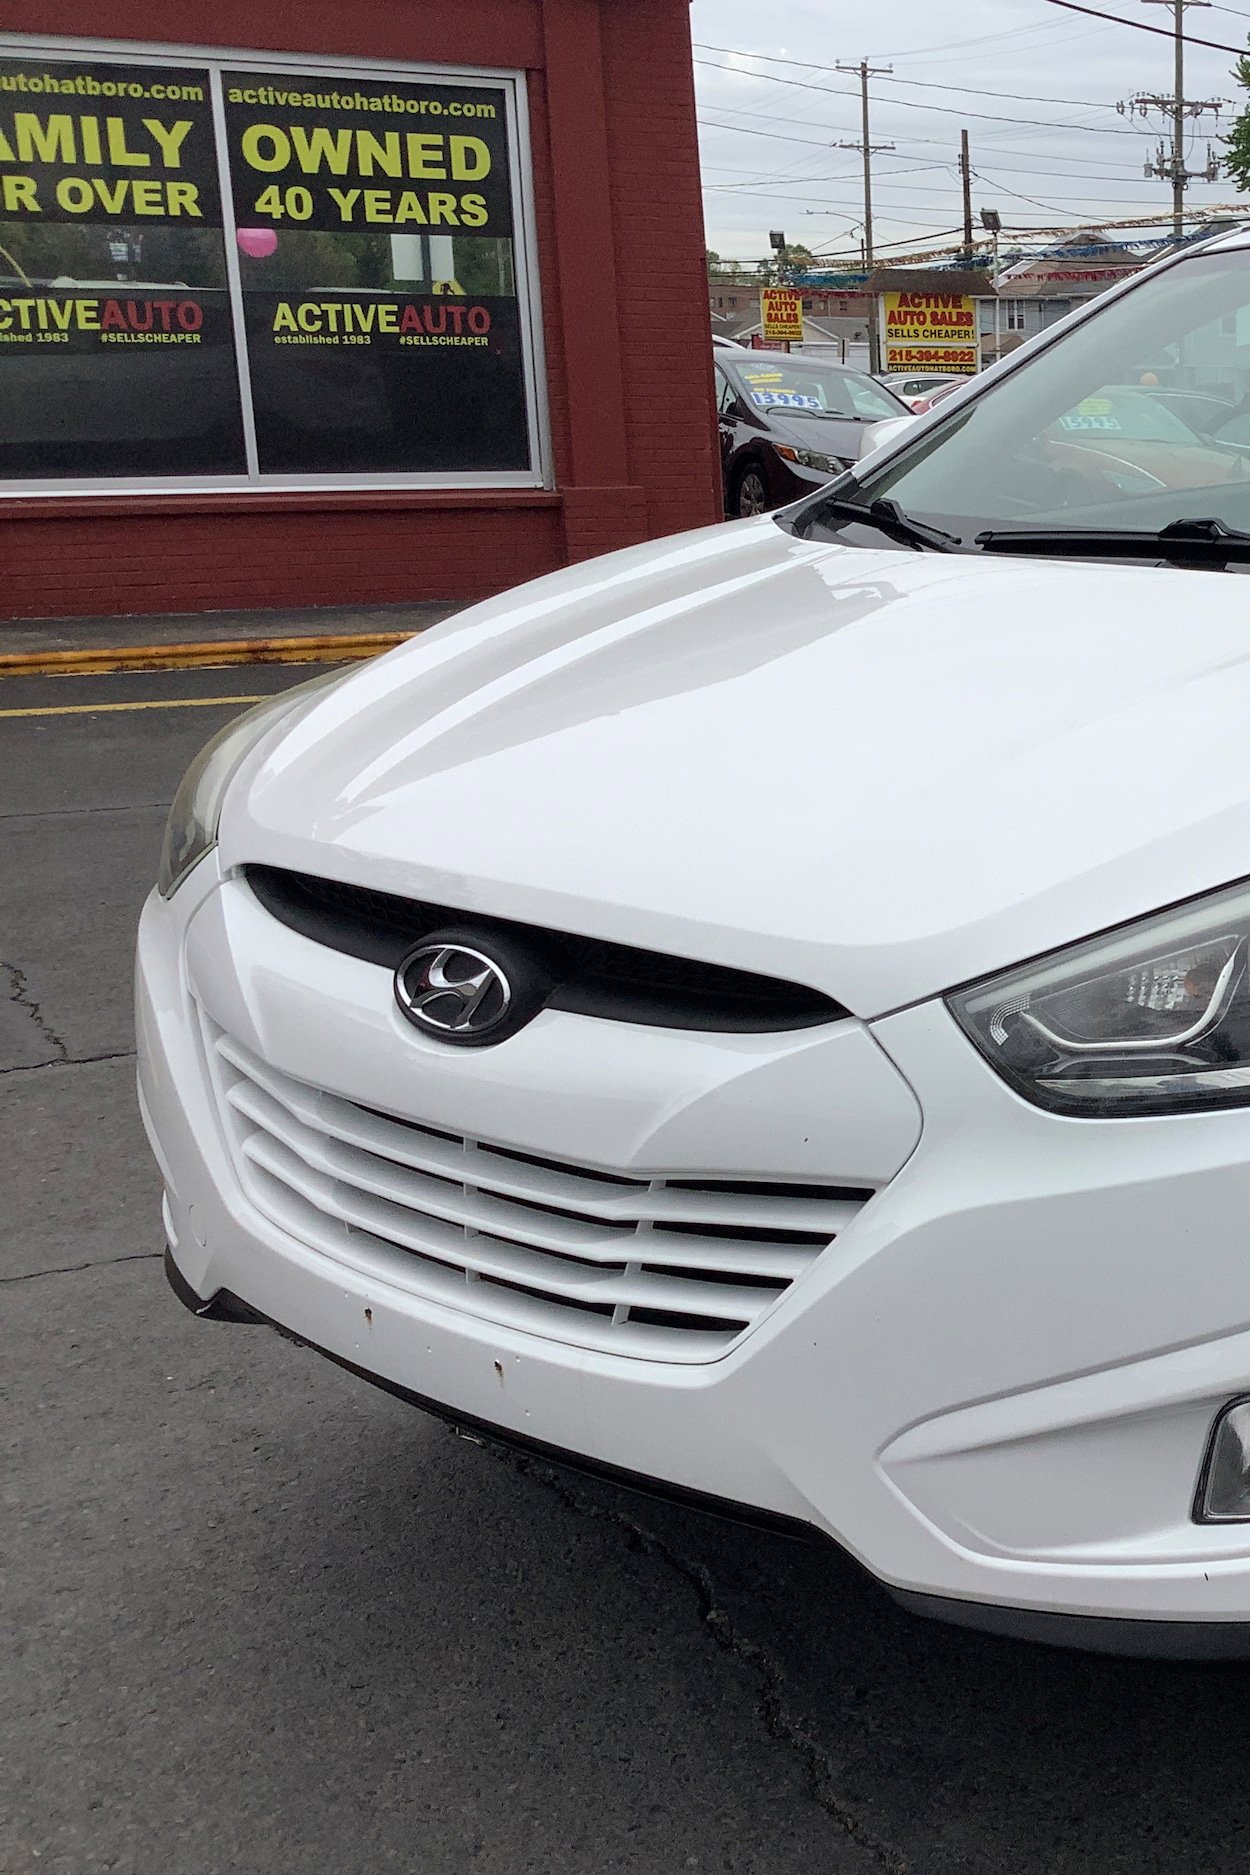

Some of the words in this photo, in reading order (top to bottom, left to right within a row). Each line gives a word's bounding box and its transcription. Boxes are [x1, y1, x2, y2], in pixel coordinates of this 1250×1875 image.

[228, 87, 496, 119] activeautohatboro.com
[242, 124, 492, 182] OWNED
[56, 177, 203, 217] OVER
[255, 185, 313, 221] 40
[327, 188, 489, 227] YEARS
[768, 301, 797, 311] AUTO
[898, 292, 962, 309] ACTIVE
[767, 312, 798, 323] SALES
[888, 310, 927, 326] AUTO
[930, 311, 973, 326] SALES
[36, 333, 69, 343] 1983
[101, 333, 201, 343] #SELLSCHEAPER
[274, 335, 339, 345] established
[342, 335, 371, 345] 1983
[888, 329, 920, 338] SELLS
[922, 330, 974, 339] CHEAPER!
[752, 392, 819, 408] 13995
